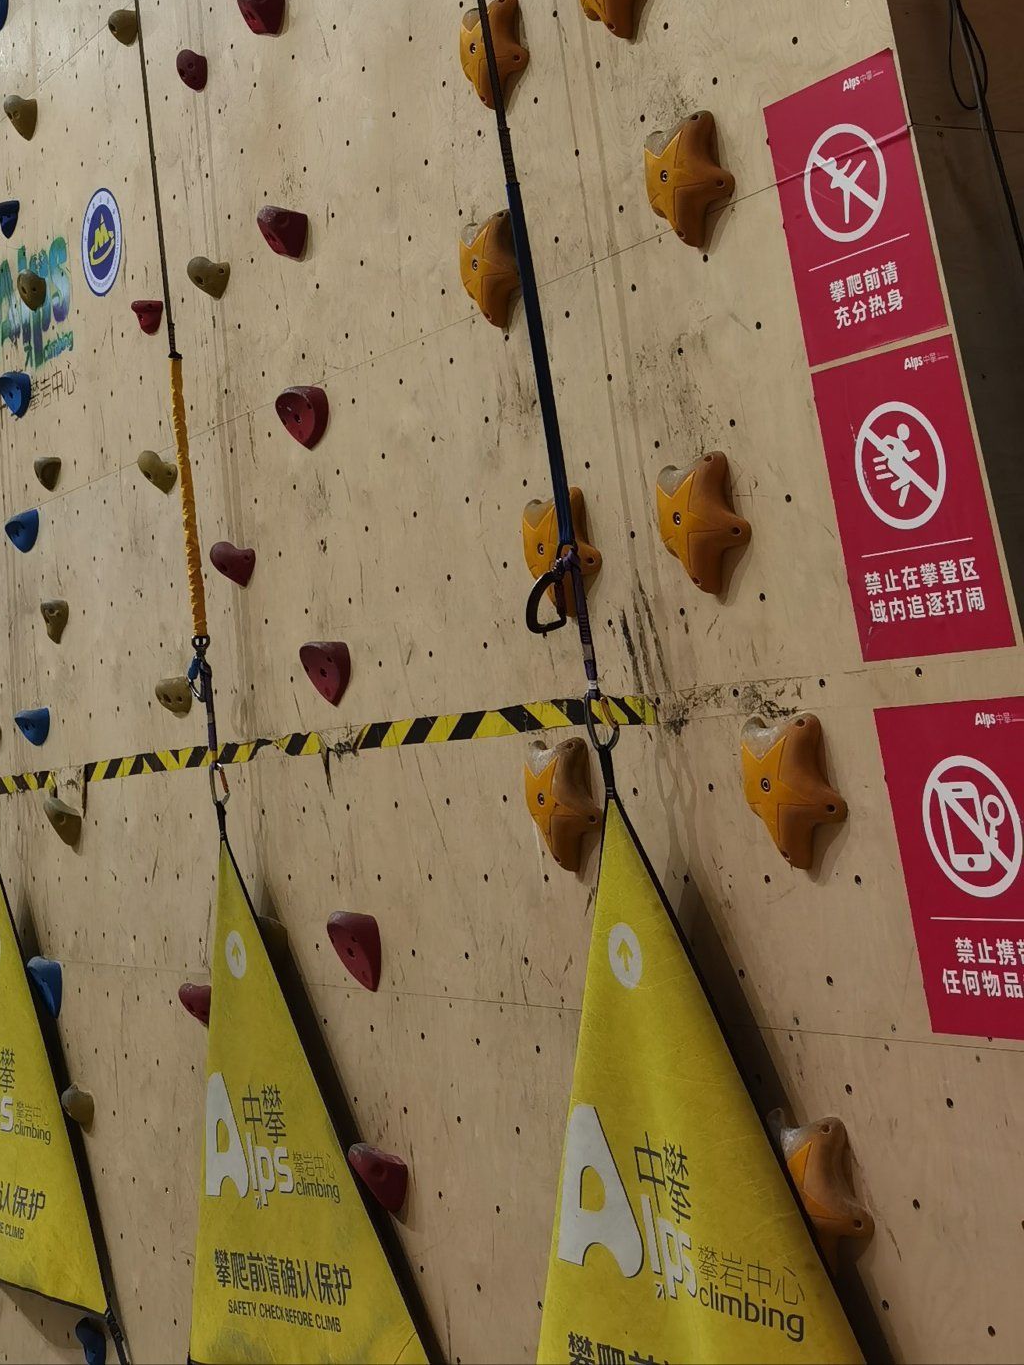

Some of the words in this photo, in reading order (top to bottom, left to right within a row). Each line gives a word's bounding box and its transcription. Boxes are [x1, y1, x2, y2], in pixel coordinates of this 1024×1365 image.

[842, 76, 860, 92] Alps
[829, 261, 899, 302] 攀爬前请
[834, 289, 904, 329] 充分热身
[904, 355, 923, 371] Alps
[864, 557, 980, 595] 禁止在攀登区
[869, 586, 986, 623] 域内追逐打闹
[975, 712, 996, 729] Alps
[942, 968, 1024, 998] 任何物品
[14, 1119, 52, 1145] climbing
[242, 1084, 287, 1144] 中攀
[205, 1071, 295, 1207] Alps
[292, 1150, 336, 1181] 攀岩中心
[634, 1130, 692, 1224] 中攀
[296, 1180, 341, 1204] climbing
[558, 1103, 698, 1301] Alps
[214, 1248, 352, 1306] 攀爬前请确认保护
[697, 1245, 806, 1306] 攀岩中心
[228, 1299, 257, 1317] SAFETY
[260, 1303, 286, 1322] CHECK
[285, 1308, 314, 1328] BEFORE
[315, 1314, 342, 1333] CLIMB
[698, 1282, 806, 1343] climbing
